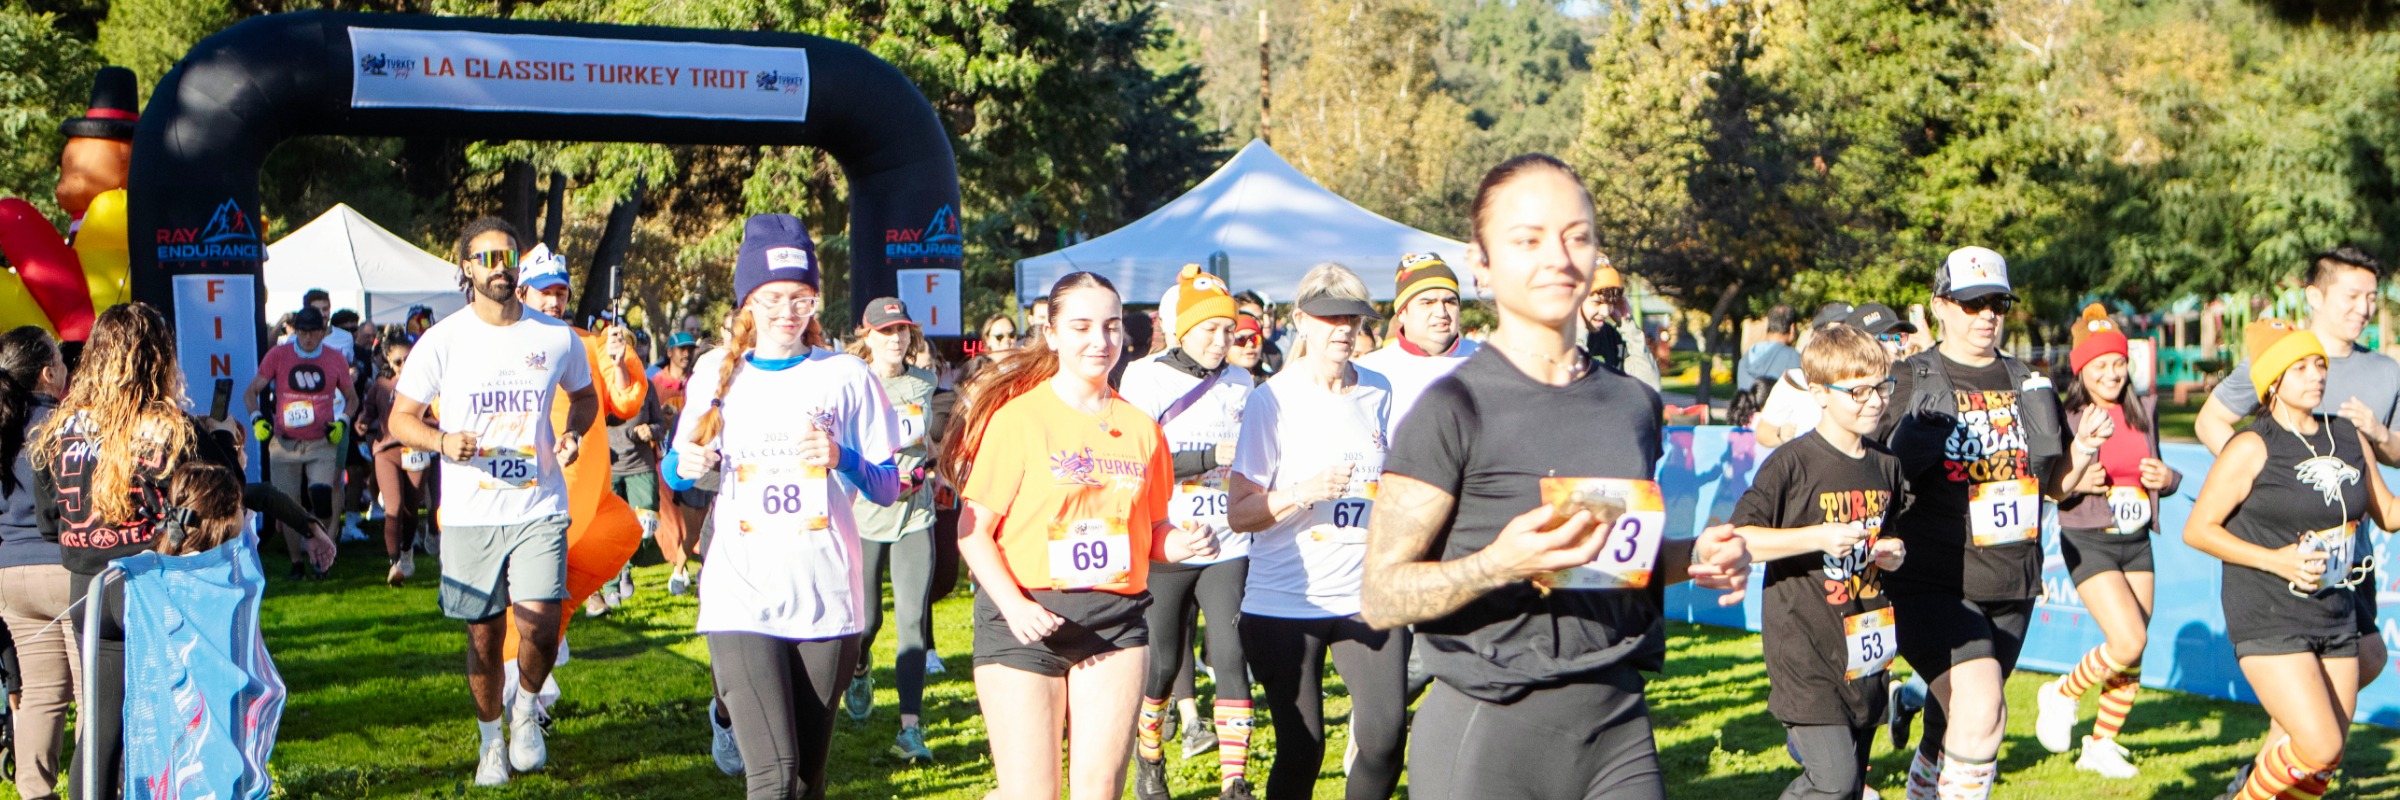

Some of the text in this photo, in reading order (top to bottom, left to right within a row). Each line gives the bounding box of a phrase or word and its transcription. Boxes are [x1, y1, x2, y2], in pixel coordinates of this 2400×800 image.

[423, 56, 749, 89] LA CLASSIC TURKEY TROT
[156, 227, 199, 244] RAY
[885, 228, 923, 242] RAY
[157, 243, 259, 259] ENDURANCE
[469, 389, 546, 415] TURKEY
[288, 408, 309, 421] 353
[764, 432, 789, 442] 2025
[1344, 452, 1364, 461] 2025
[488, 459, 527, 478] 125
[1095, 458, 1147, 477] TURKEY
[762, 483, 802, 514] 68
[1192, 493, 1228, 517] 219
[1333, 502, 1366, 528] 67
[1992, 500, 2019, 528] 51
[1072, 540, 1108, 571] 69
[1861, 631, 1884, 663] 53
